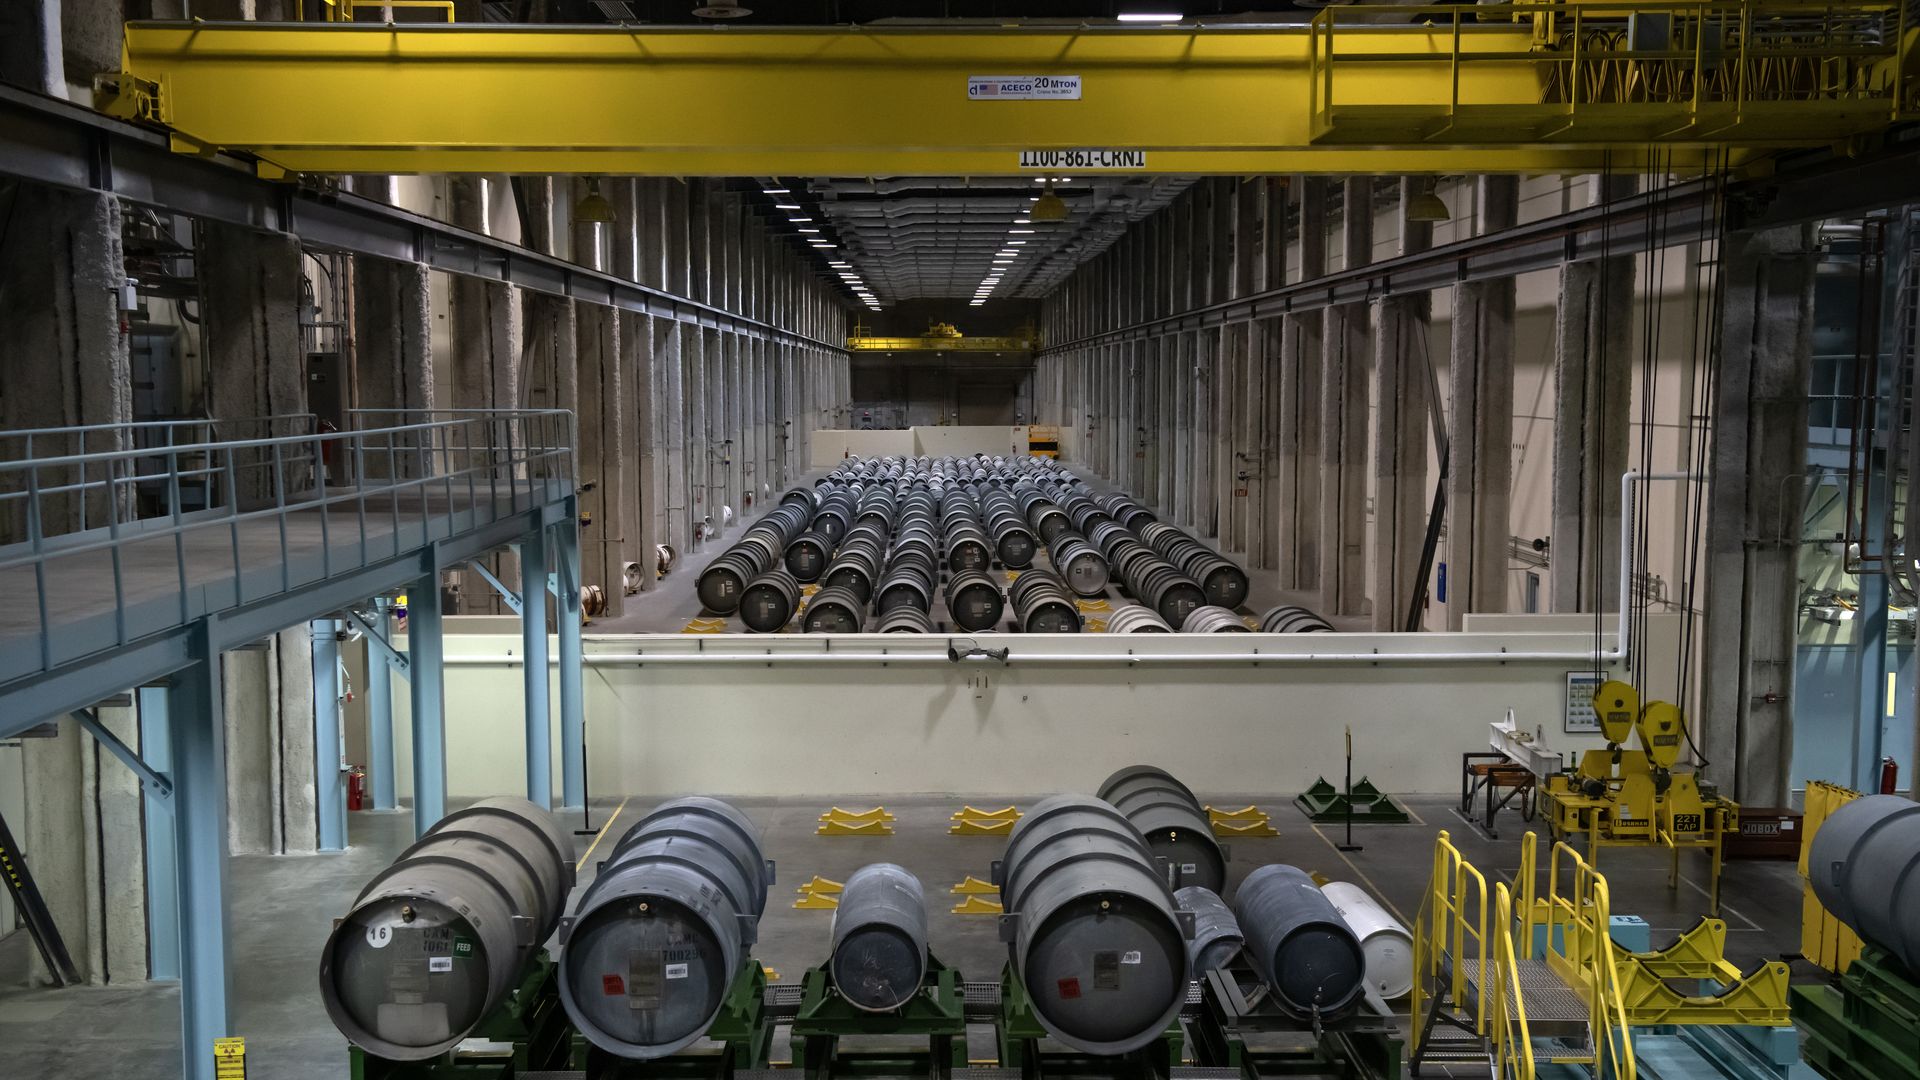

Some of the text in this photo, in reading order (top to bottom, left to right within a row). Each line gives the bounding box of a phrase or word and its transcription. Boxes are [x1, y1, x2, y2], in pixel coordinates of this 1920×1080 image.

[1034, 77, 1077, 88] 20 MTON
[1020, 151, 1145, 167] 1100-861-CRN1
[1676, 815, 1698, 823] 22T
[1676, 823, 1697, 831] CAP
[1743, 823, 1778, 833] JOBOX
[456, 942, 471, 952] FEED
